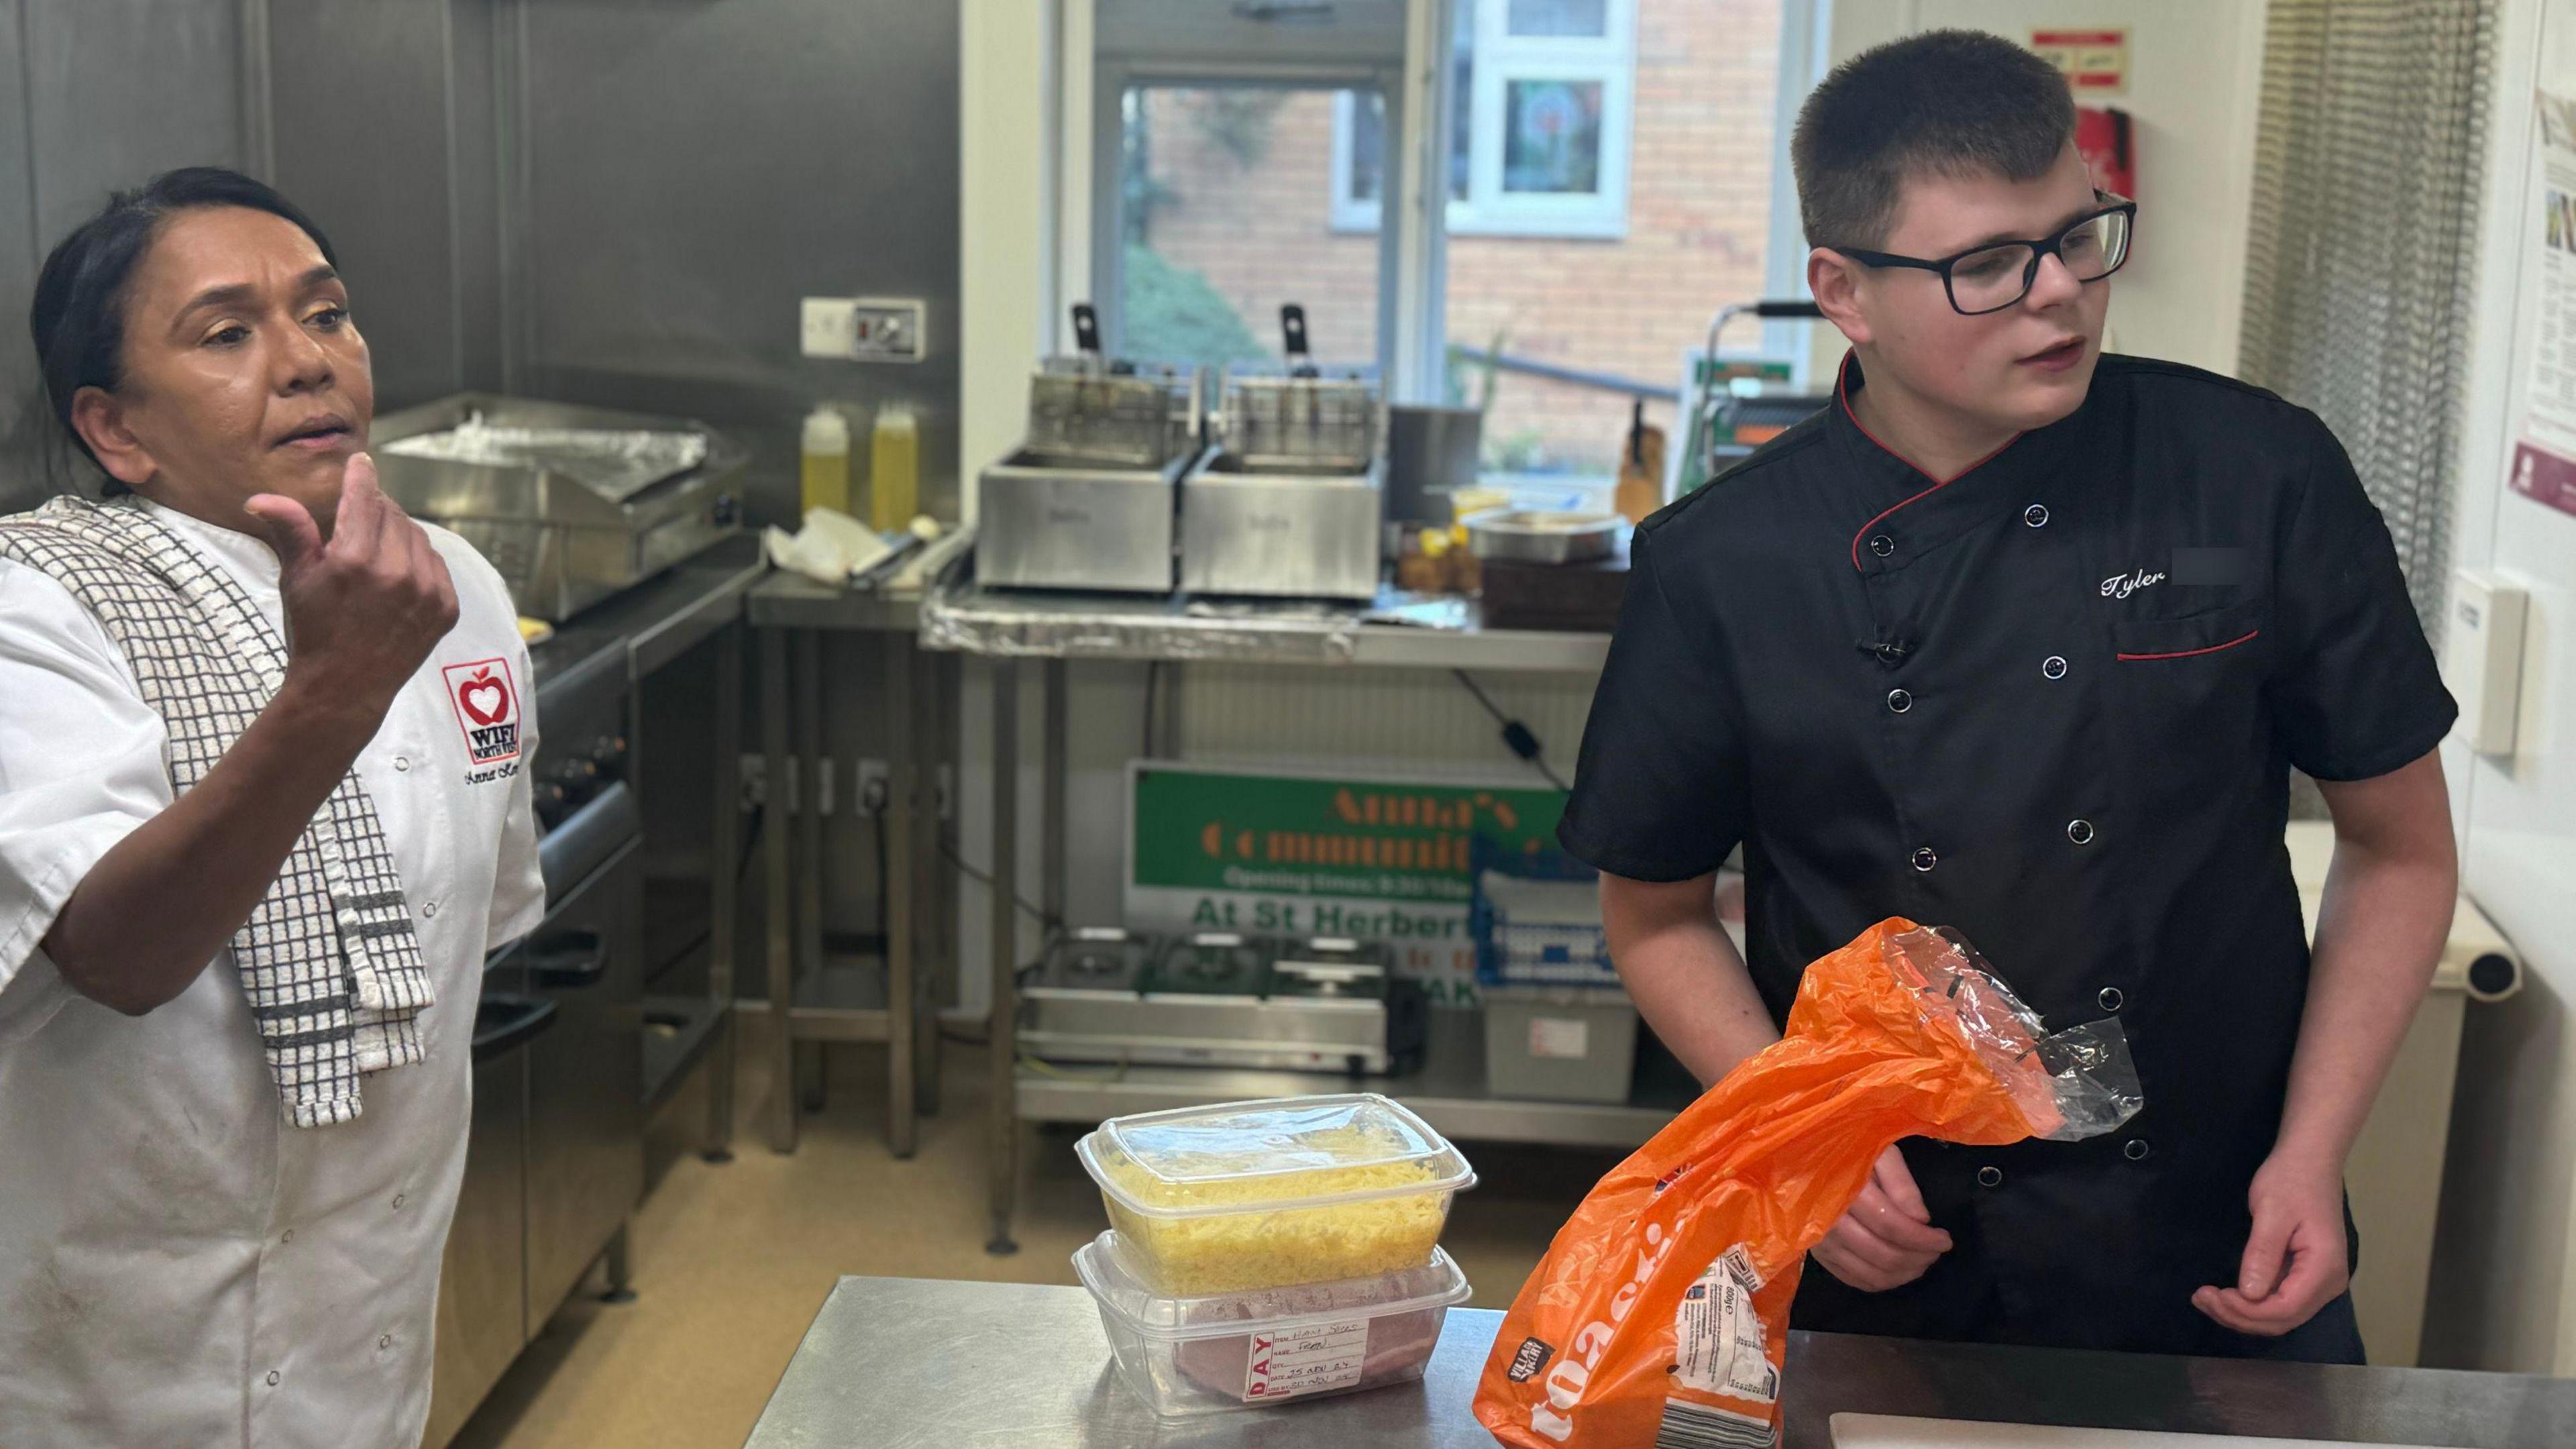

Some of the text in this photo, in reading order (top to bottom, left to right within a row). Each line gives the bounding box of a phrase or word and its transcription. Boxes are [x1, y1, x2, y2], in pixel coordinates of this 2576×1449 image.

[2100, 568, 2166, 599] Tyler
[470, 724, 515, 747] WIFI
[464, 770, 496, 785] Anna
[1201, 822, 1470, 870] Communit
[1193, 896, 1236, 928] At
[1254, 899, 1296, 931] St
[1249, 1337, 1272, 1395] DAY
